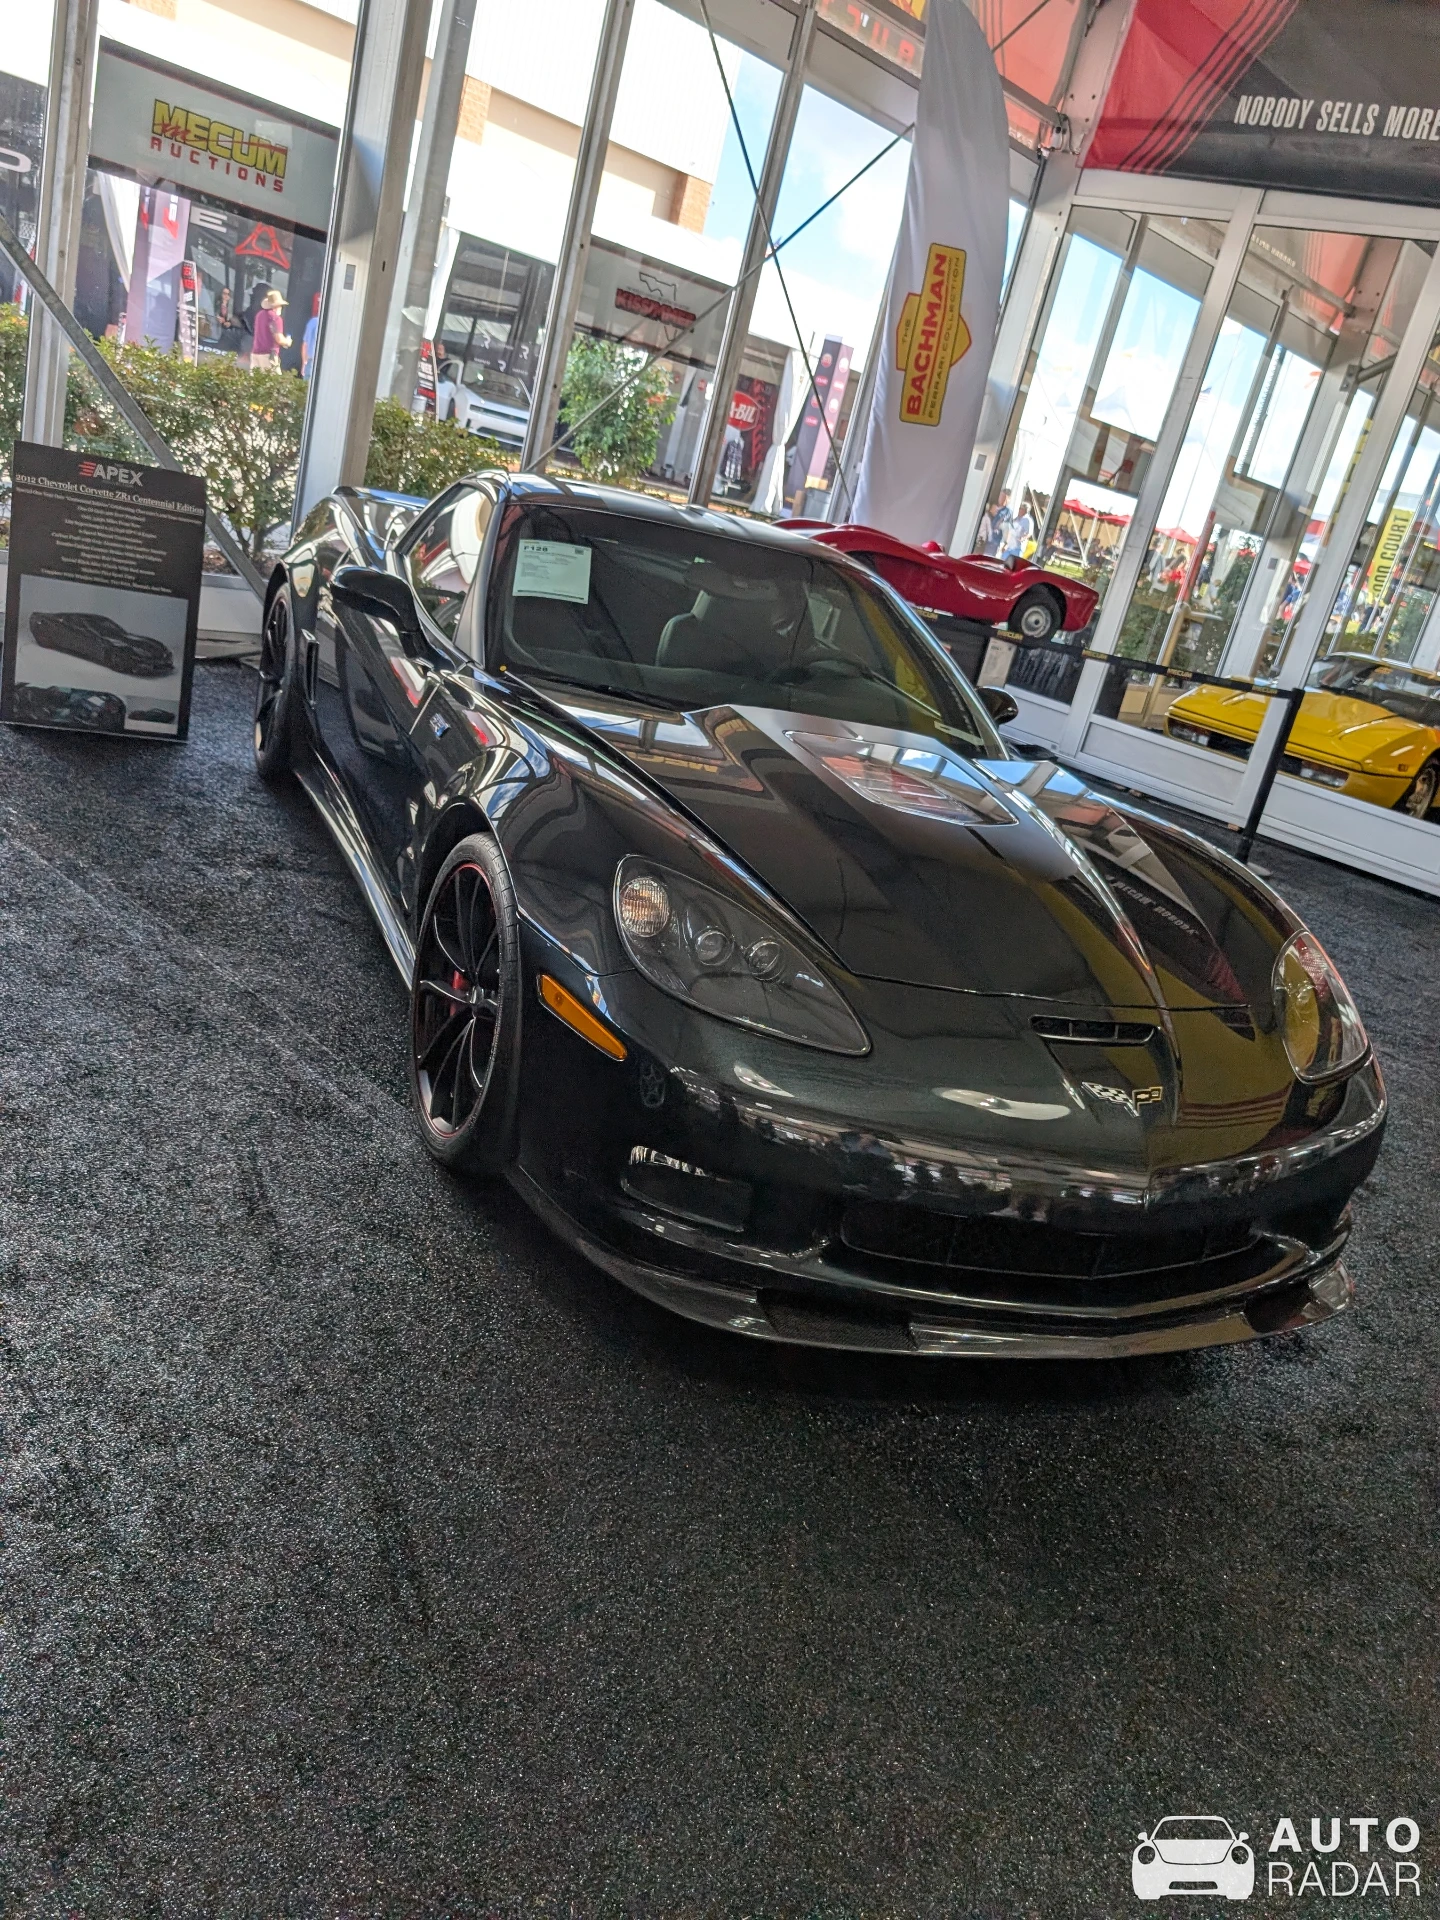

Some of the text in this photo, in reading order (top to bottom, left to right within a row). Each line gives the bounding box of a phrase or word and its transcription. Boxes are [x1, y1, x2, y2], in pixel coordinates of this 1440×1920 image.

[152, 98, 289, 179] MECUM
[1234, 95, 1440, 141] NOBODY SELLS MORE
[150, 136, 284, 193] AUCTIONS
[942, 257, 960, 352] COLLECTION
[906, 253, 948, 416] BACHMAN
[15, 474, 37, 485] 2012
[38, 476, 78, 492] Chevrolet
[79, 483, 115, 499] Corvette
[132, 494, 175, 510] Centennial
[176, 502, 204, 515] Edition
[93, 463, 144, 487] APEX
